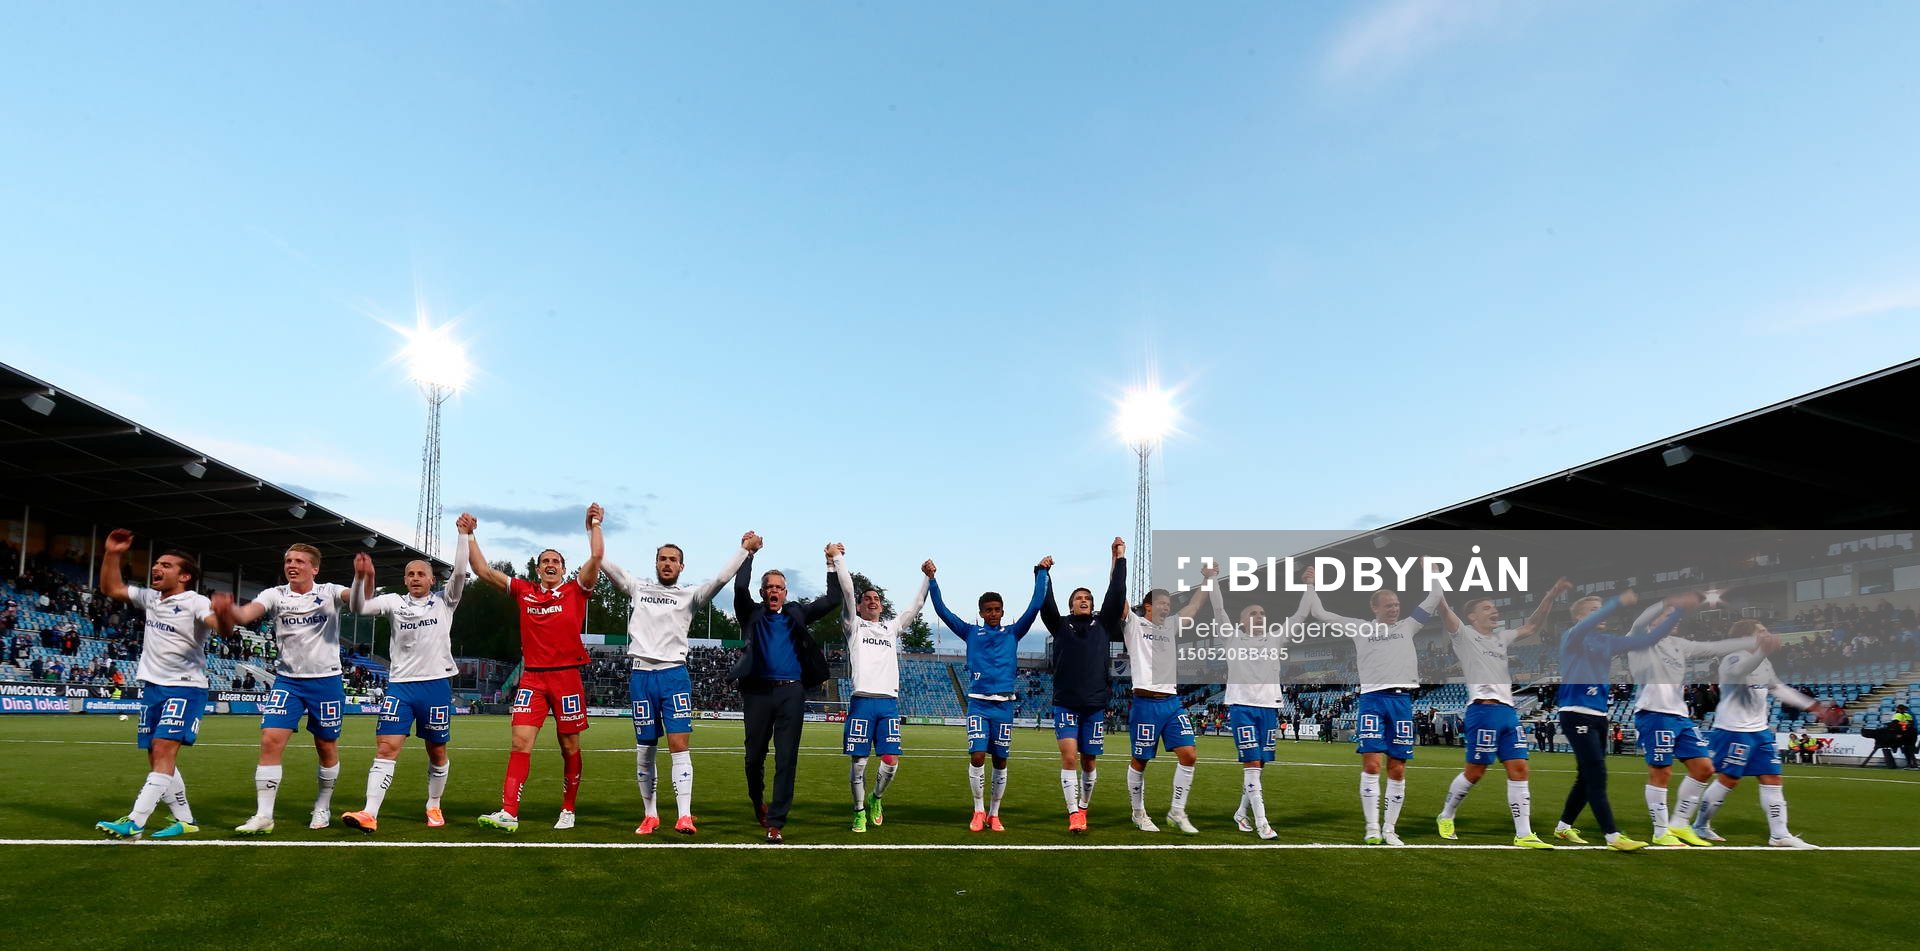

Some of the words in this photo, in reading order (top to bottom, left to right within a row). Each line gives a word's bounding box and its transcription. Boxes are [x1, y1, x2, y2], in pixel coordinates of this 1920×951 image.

[641, 596, 677, 605] HOLMEN
[527, 605, 562, 614] HOLMEN
[281, 615, 328, 625] HOLMEN
[400, 618, 438, 630] HOLMEN
[862, 638, 892, 648] HOLME
[66, 686, 88, 697] kvm
[218, 692, 240, 701] LÄGGER
[2, 698, 33, 711] Dina
[35, 698, 71, 711] lokala
[1474, 752, 1480, 760] 6
[1654, 753, 1664, 761] 21
[380, 773, 393, 790] SITA
[1174, 785, 1184, 800] SITA
[1769, 804, 1781, 818] SITA
